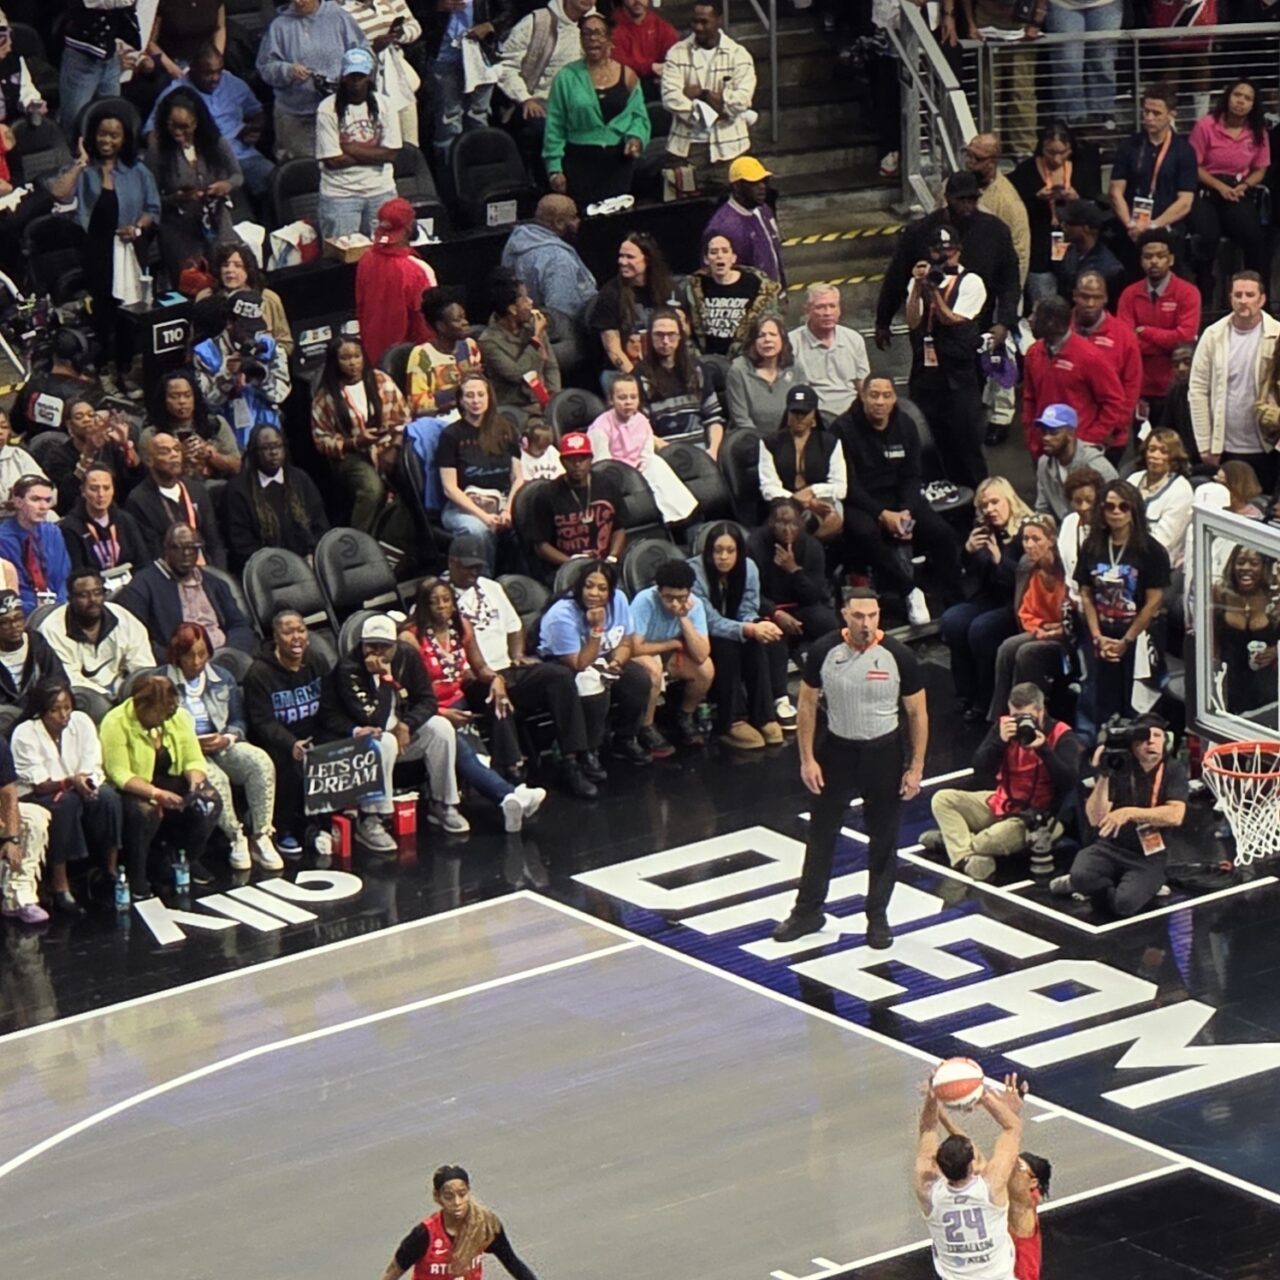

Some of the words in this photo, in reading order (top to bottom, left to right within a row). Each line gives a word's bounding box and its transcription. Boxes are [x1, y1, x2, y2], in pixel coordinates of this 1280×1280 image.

[307, 758, 350, 778] LET'S
[352, 751, 376, 770] GO
[307, 764, 378, 796] DREAM
[942, 1207, 987, 1243] 24
